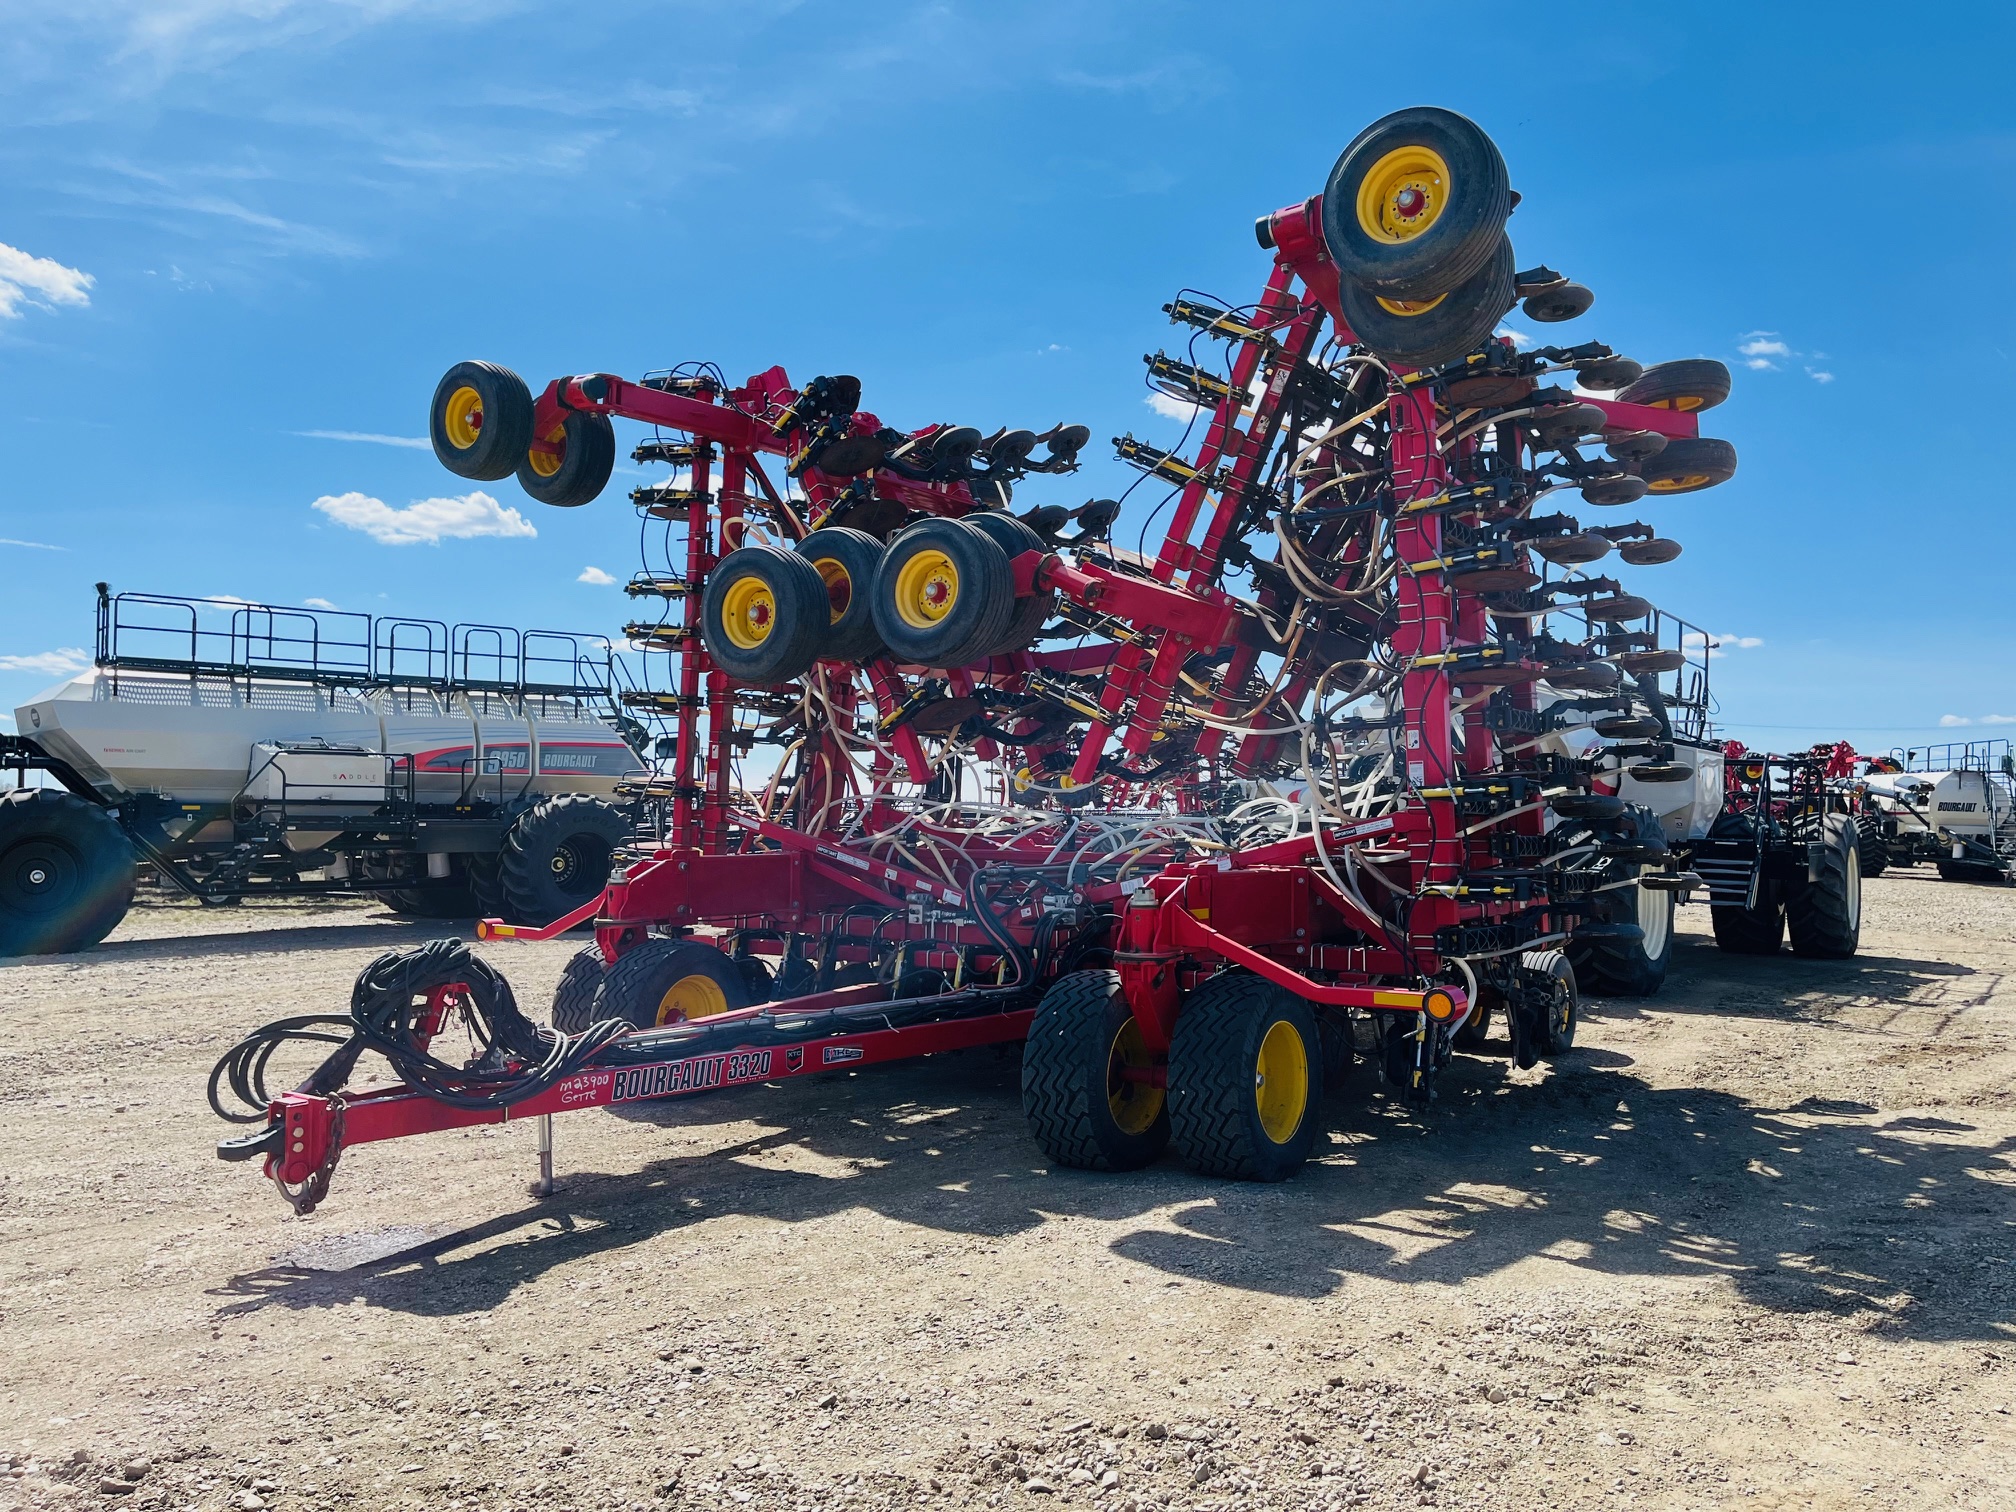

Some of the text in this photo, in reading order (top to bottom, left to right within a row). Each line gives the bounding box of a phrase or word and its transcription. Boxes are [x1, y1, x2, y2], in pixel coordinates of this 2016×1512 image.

[543, 753, 598, 768] BOURGAULT
[1937, 801, 1978, 813] BOURGAULT
[787, 1050, 802, 1058] XTC
[611, 1050, 772, 1102] BOURGAULT 3320
